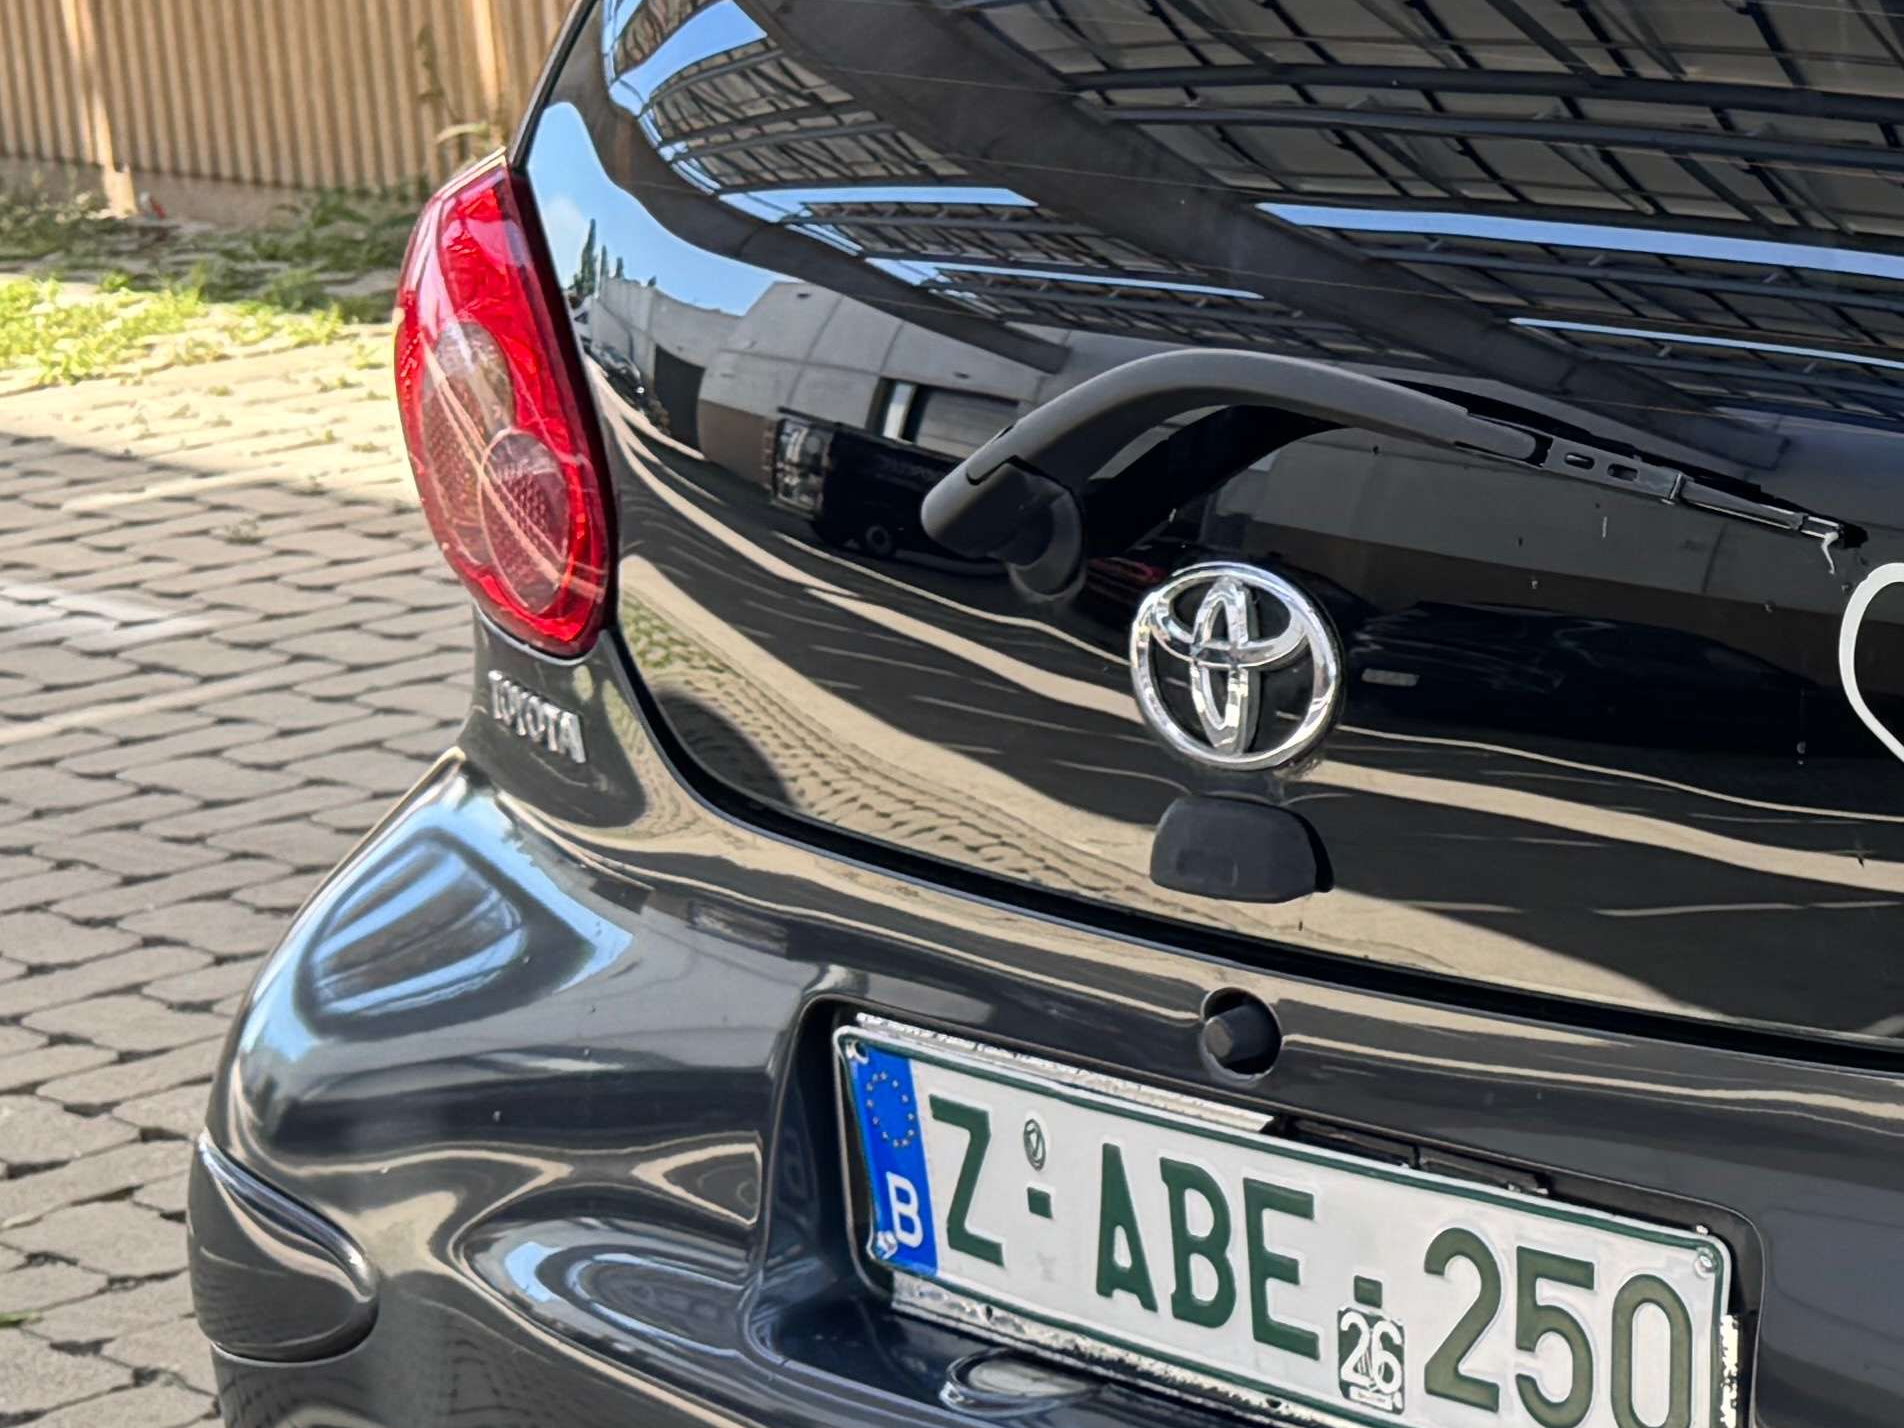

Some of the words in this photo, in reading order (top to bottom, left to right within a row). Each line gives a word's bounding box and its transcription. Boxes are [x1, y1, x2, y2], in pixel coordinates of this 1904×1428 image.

[487, 669, 587, 764] TOYOTA
[885, 1171, 923, 1247] B
[1340, 1310, 1402, 1396] 26
